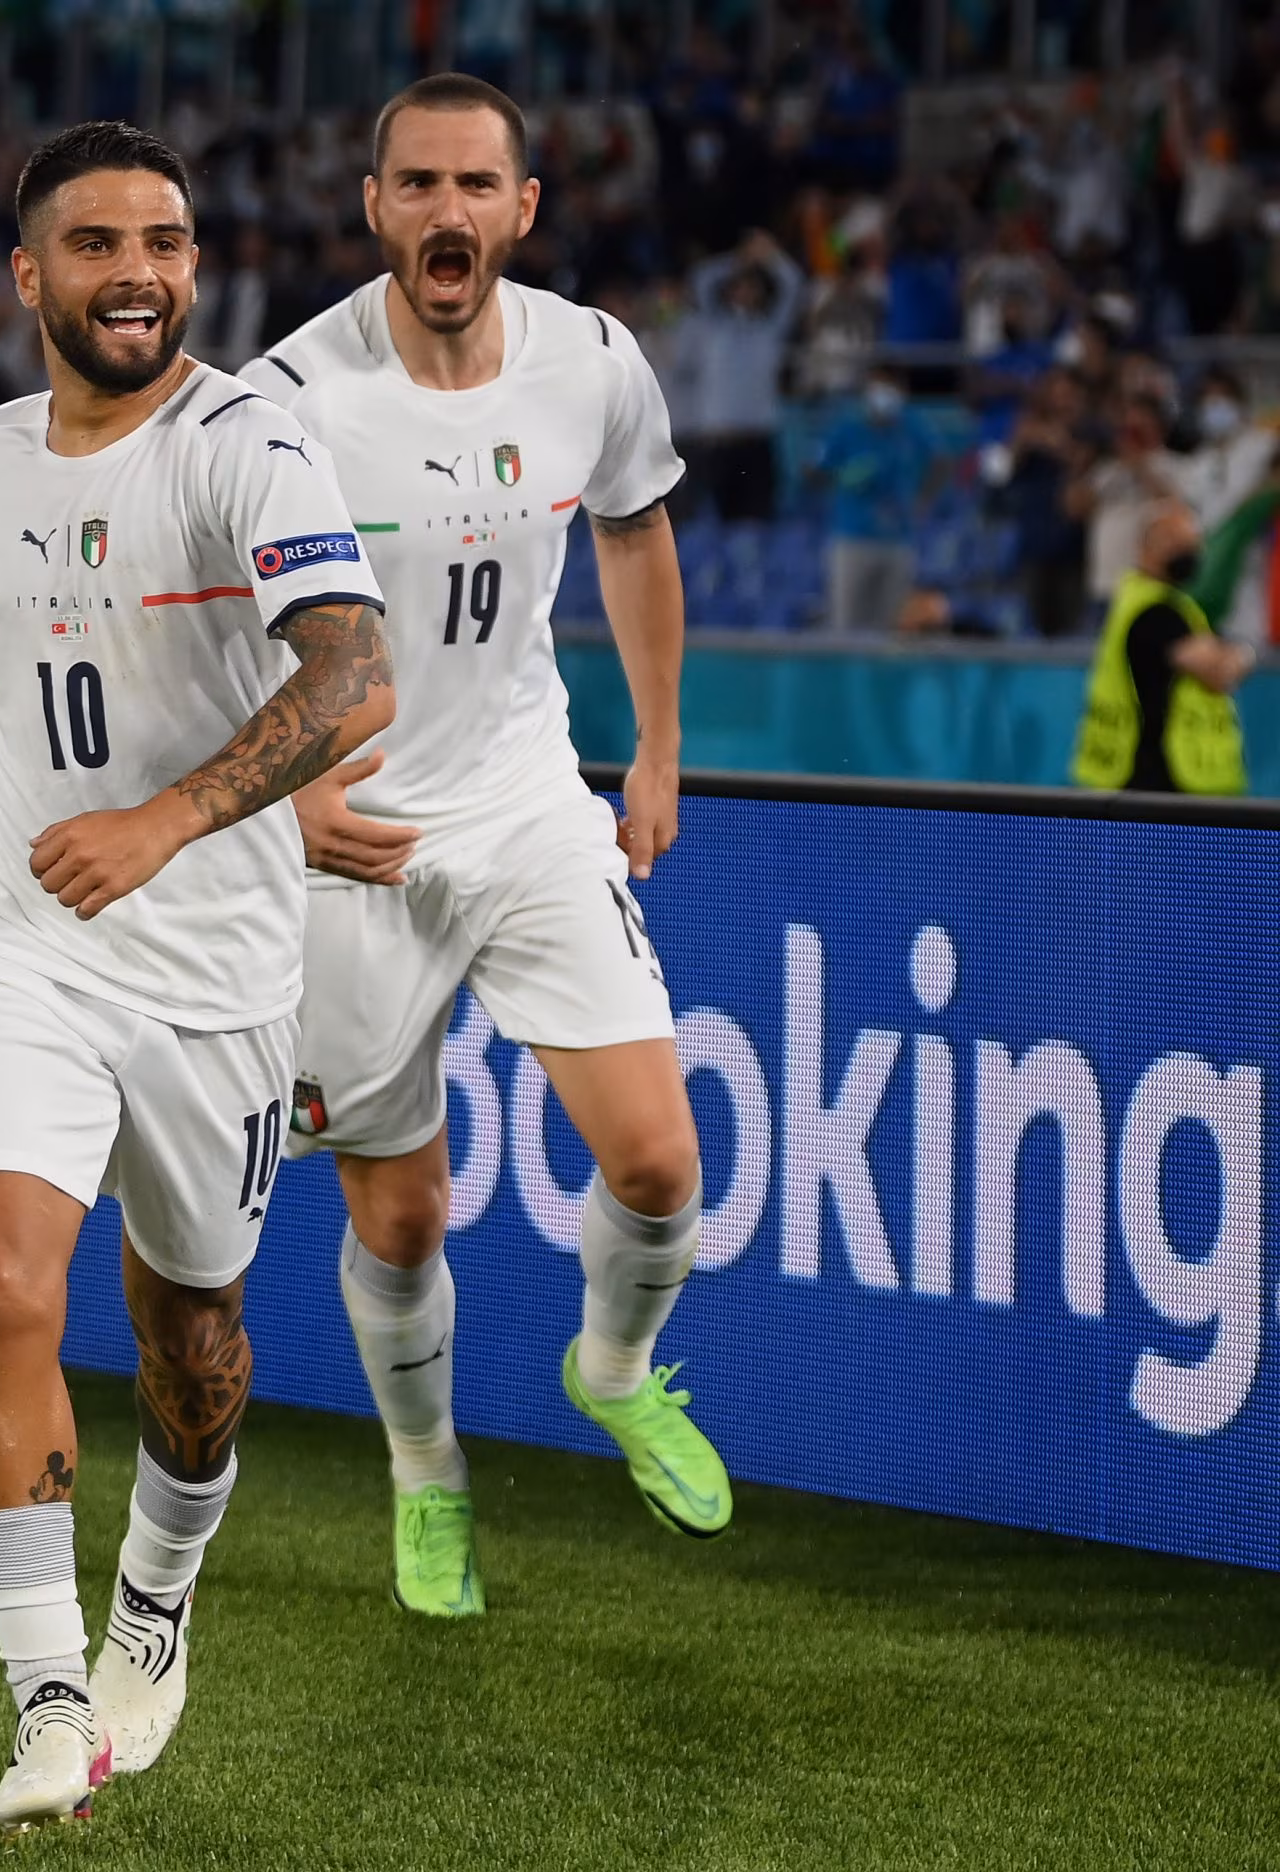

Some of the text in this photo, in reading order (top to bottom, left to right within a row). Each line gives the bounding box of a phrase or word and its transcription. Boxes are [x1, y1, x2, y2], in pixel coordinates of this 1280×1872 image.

[427, 508, 528, 528] ITALIA
[284, 541, 356, 561] RESPECT
[17, 596, 113, 609] ITALIA
[444, 559, 501, 645] 19
[36, 661, 110, 770] 10
[239, 1099, 281, 1210] 10
[35, 1688, 76, 1701] COPA
